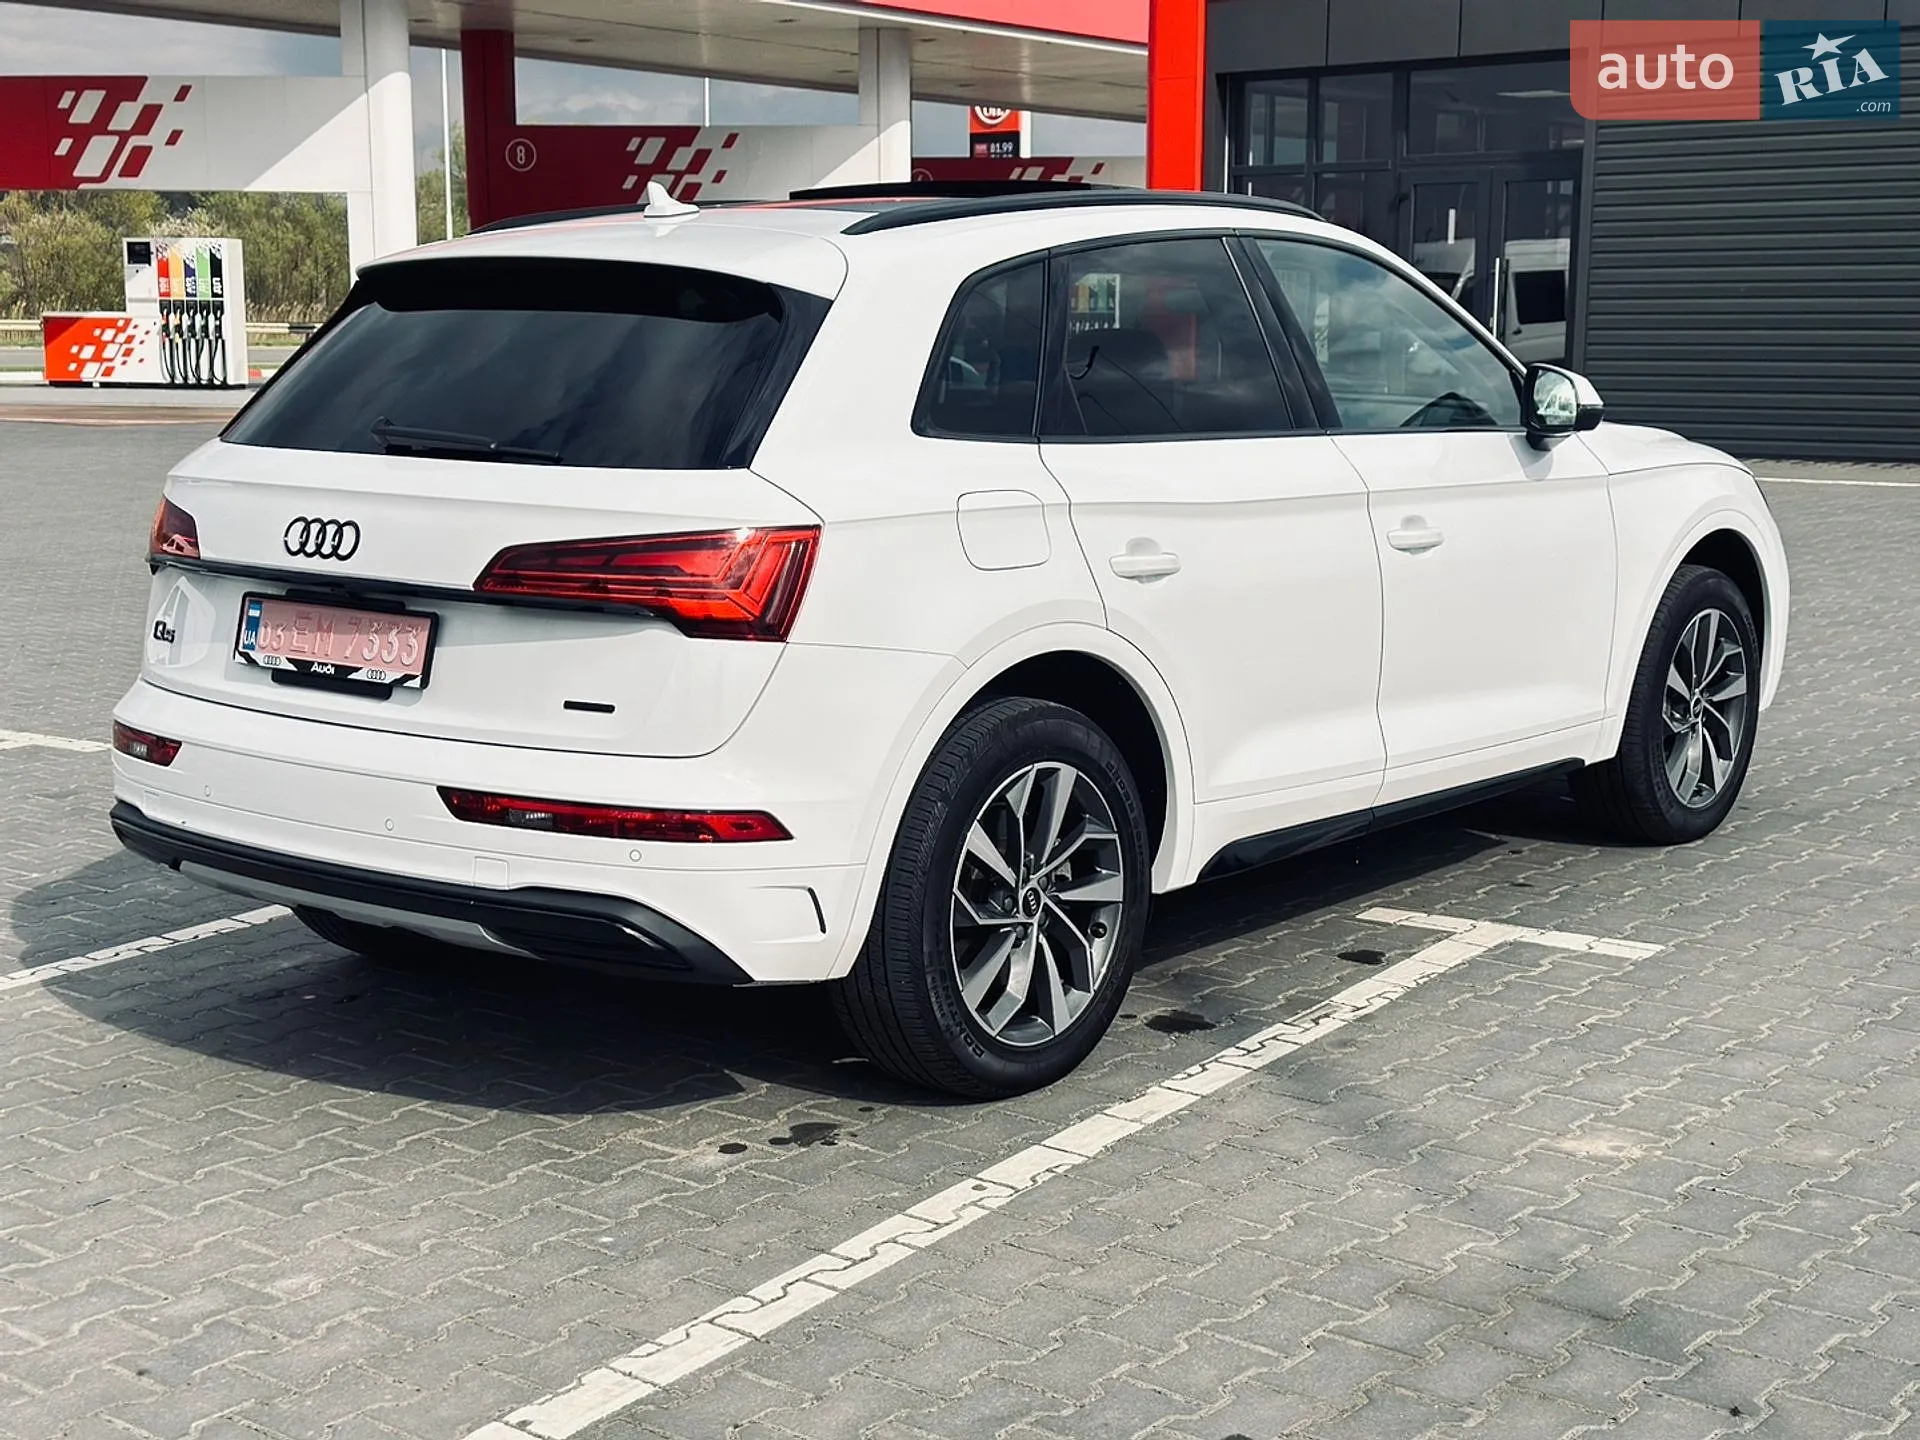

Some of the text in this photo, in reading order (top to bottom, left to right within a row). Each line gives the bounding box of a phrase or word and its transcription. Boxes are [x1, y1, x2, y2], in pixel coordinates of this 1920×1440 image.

[516, 145, 526, 165] 8
[153, 620, 176, 643] Q5
[243, 630, 256, 645] UA
[258, 619, 286, 651] 03
[343, 617, 422, 666] 7333
[310, 661, 335, 675] Audi
